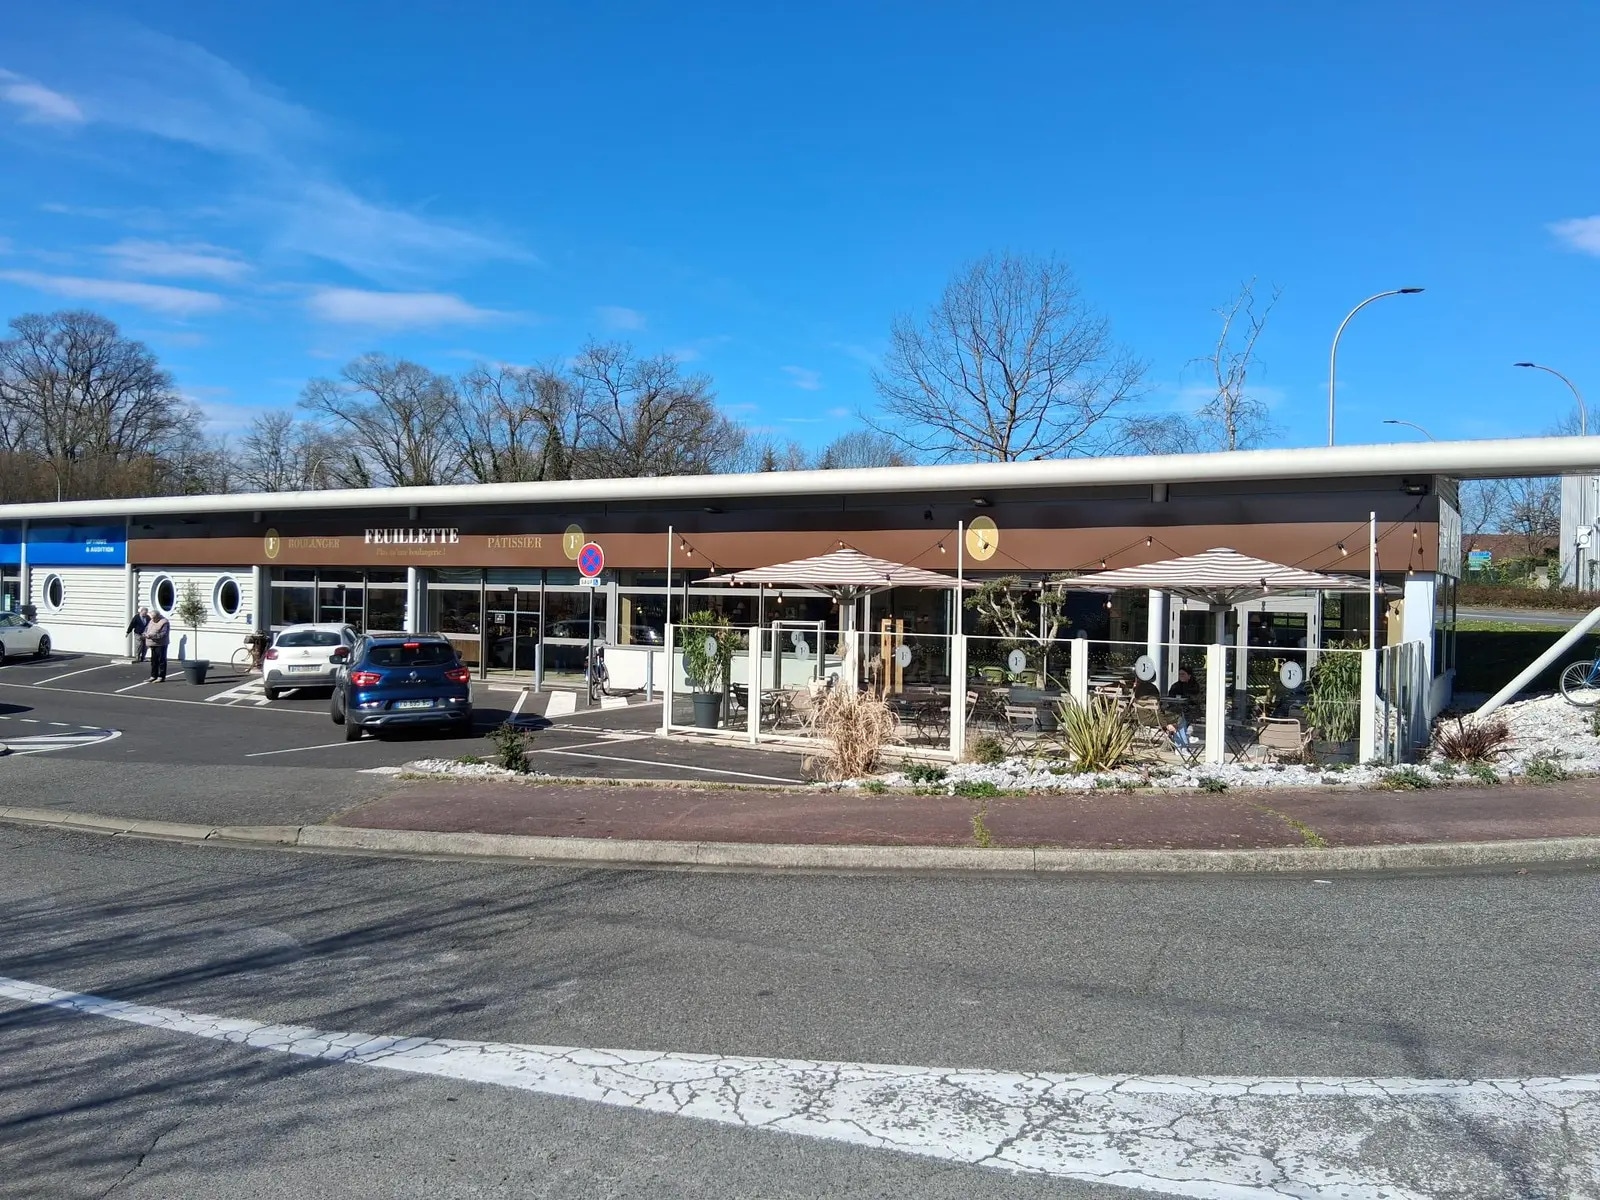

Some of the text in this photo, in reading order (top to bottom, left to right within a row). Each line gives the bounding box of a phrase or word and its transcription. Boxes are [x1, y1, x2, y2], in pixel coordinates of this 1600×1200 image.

[364, 527, 459, 544] FEUILLETTE
[268, 537, 277, 550] F
[288, 538, 340, 549] BOULANGER
